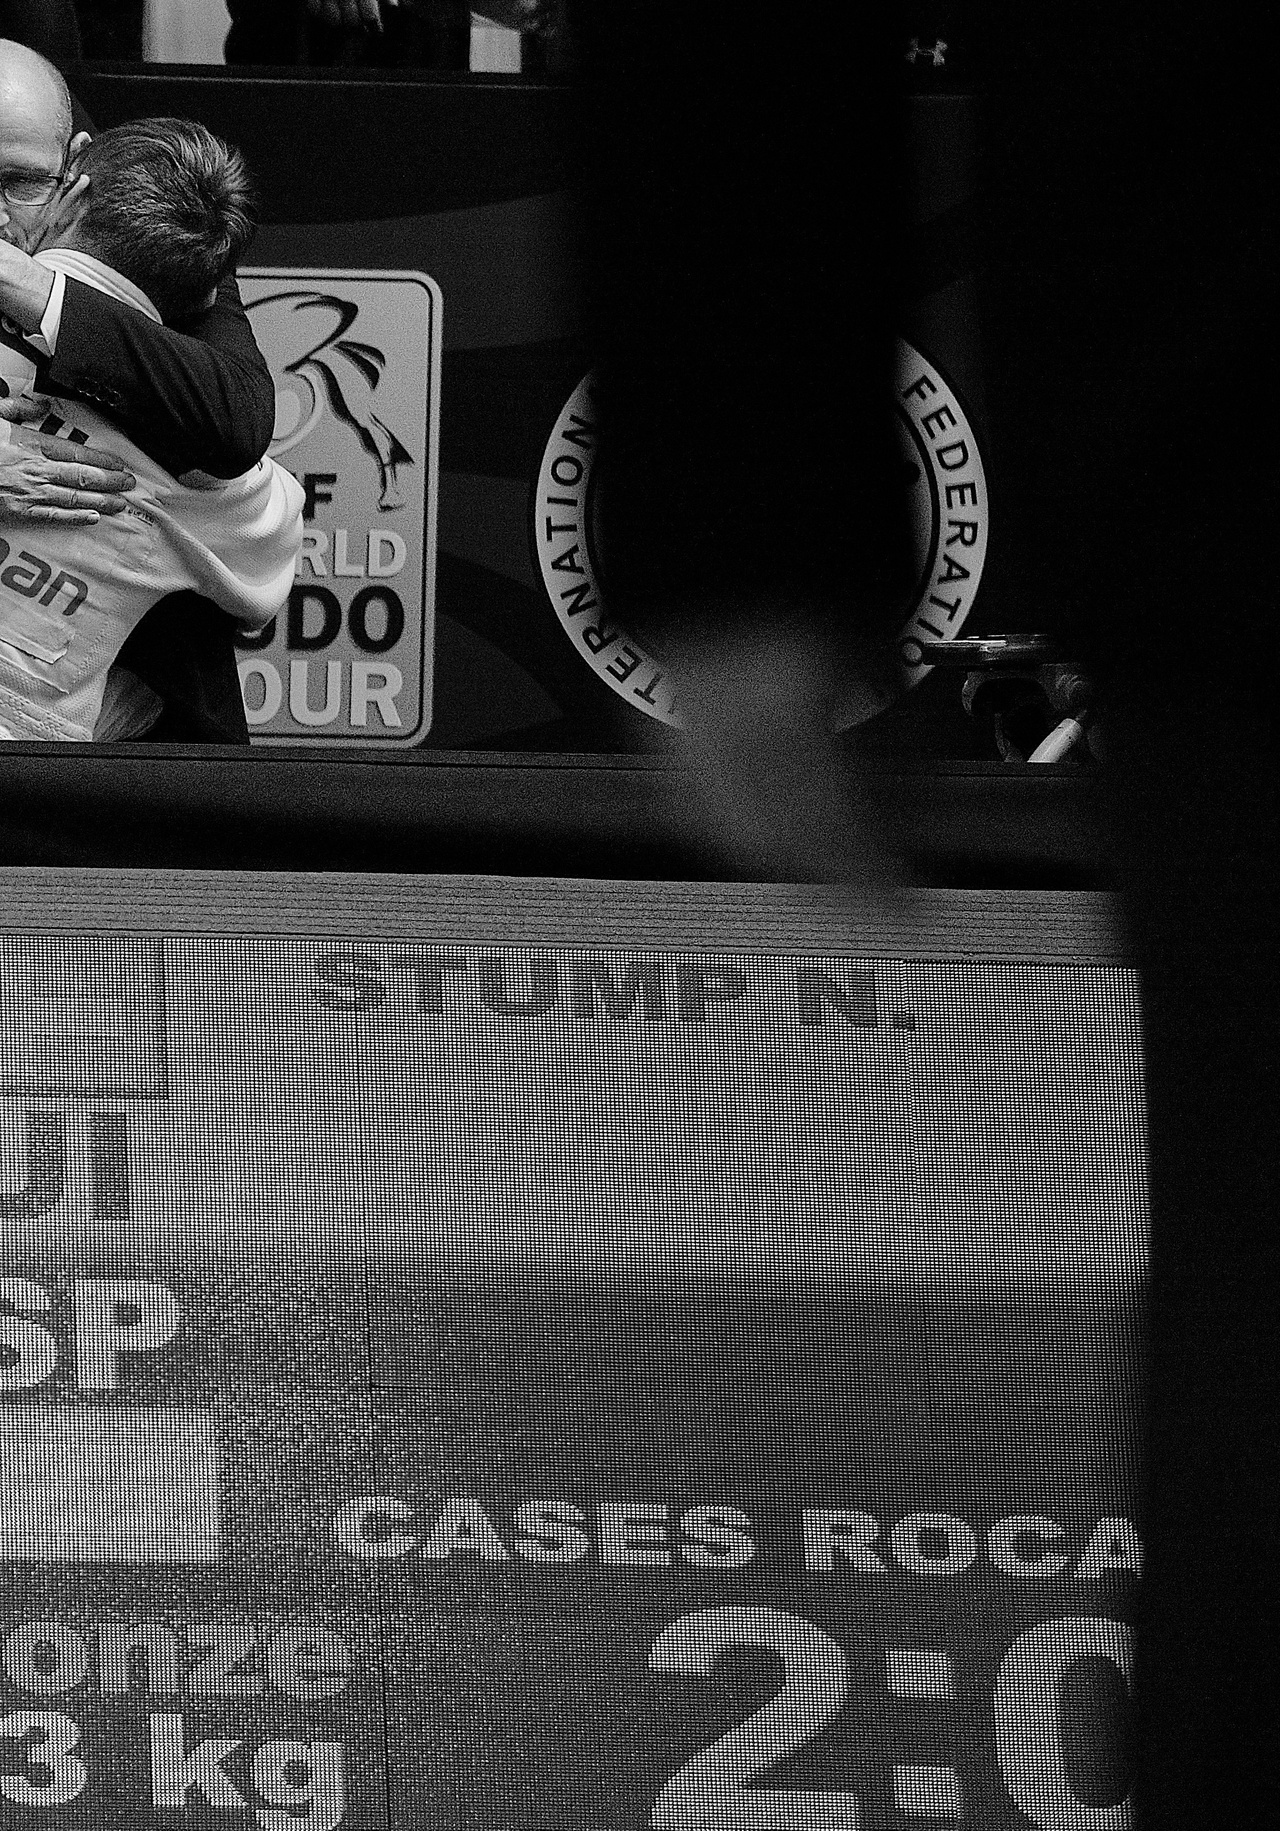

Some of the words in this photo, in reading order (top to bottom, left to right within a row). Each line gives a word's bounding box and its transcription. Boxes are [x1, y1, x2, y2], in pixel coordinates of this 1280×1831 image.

[295, 528, 407, 578] RLD
[901, 374, 979, 668] FEDERATIO
[546, 412, 678, 716] TERNATION
[237, 658, 403, 728] OUR
[312, 951, 748, 1023] STUMP
[796, 967, 918, 1032] N.
[331, 1495, 757, 1569] CASES
[802, 1508, 1144, 1580] ROCA
[149, 1713, 346, 1831] kg
